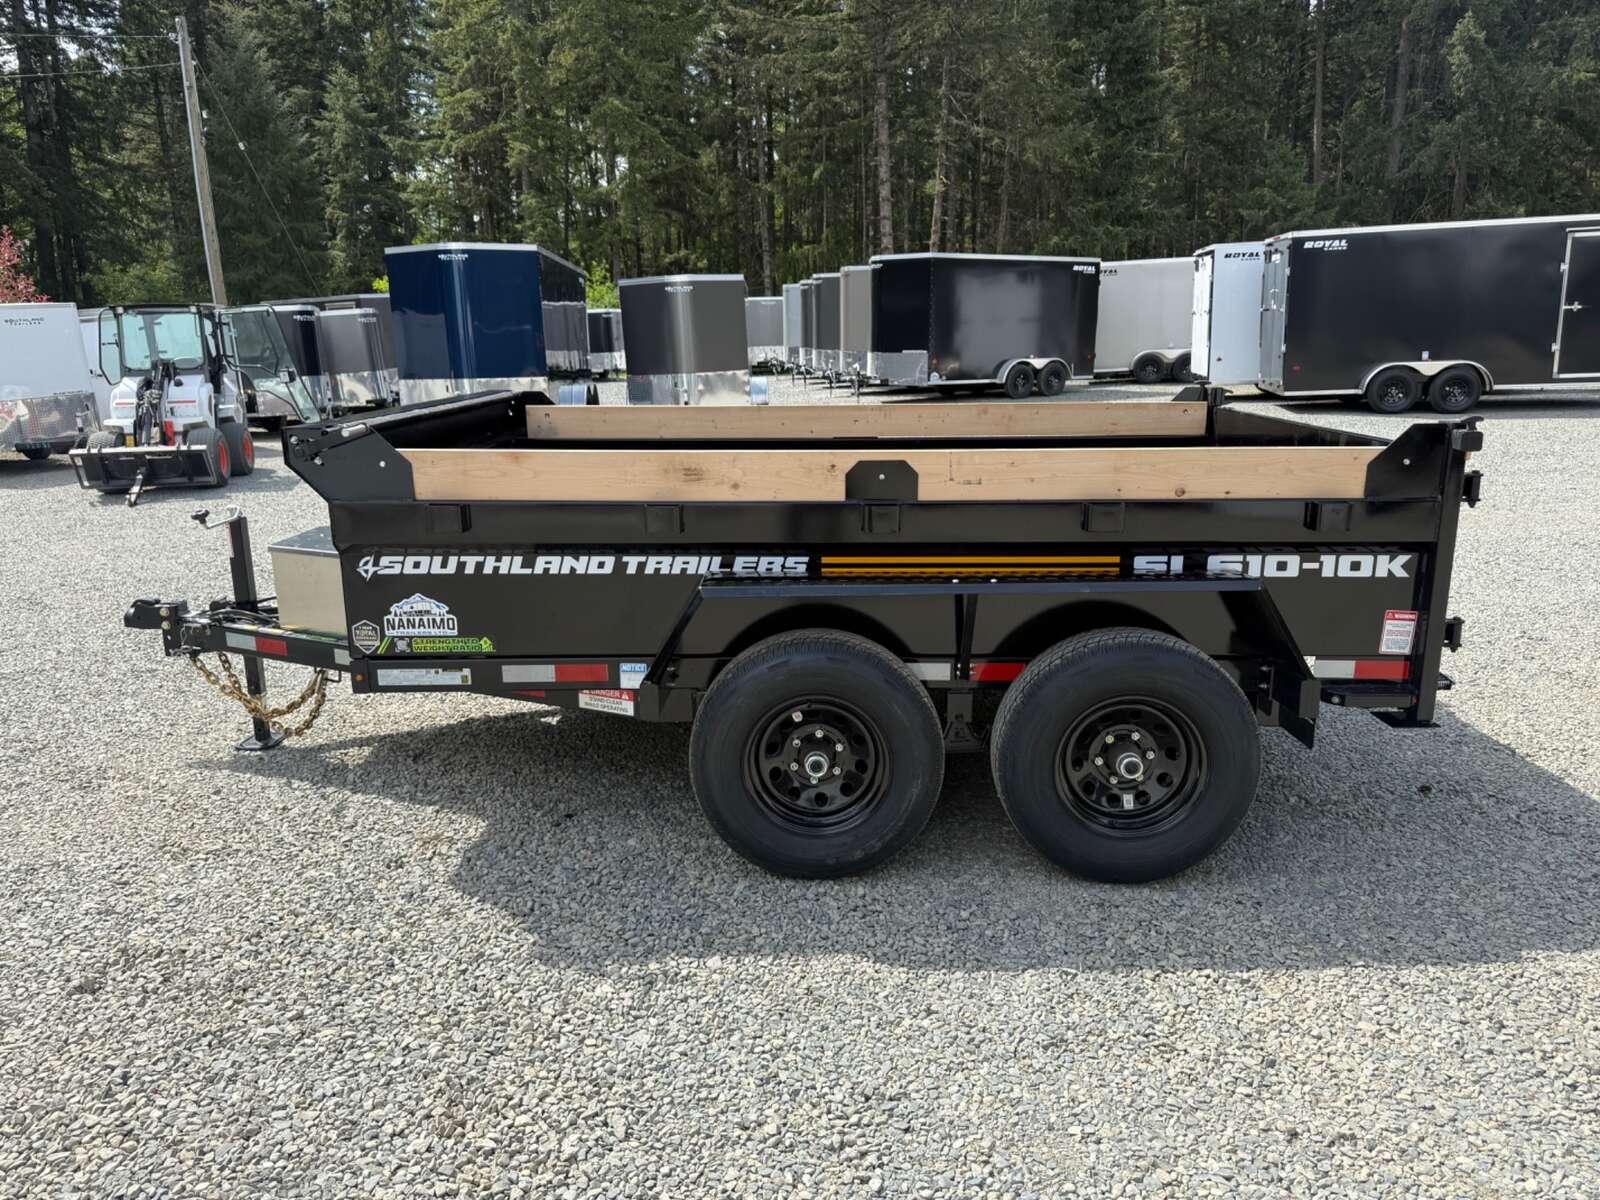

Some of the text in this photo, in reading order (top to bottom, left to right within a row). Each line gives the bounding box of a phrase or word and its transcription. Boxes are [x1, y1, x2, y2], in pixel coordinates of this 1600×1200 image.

[1303, 239, 1349, 248] ROYAL
[1224, 251, 1261, 259] ROYAL
[377, 555, 810, 577] SOUTHLAND TRAILERS
[386, 617, 456, 631] NANAIMO
[621, 663, 646, 672] NOTICE
